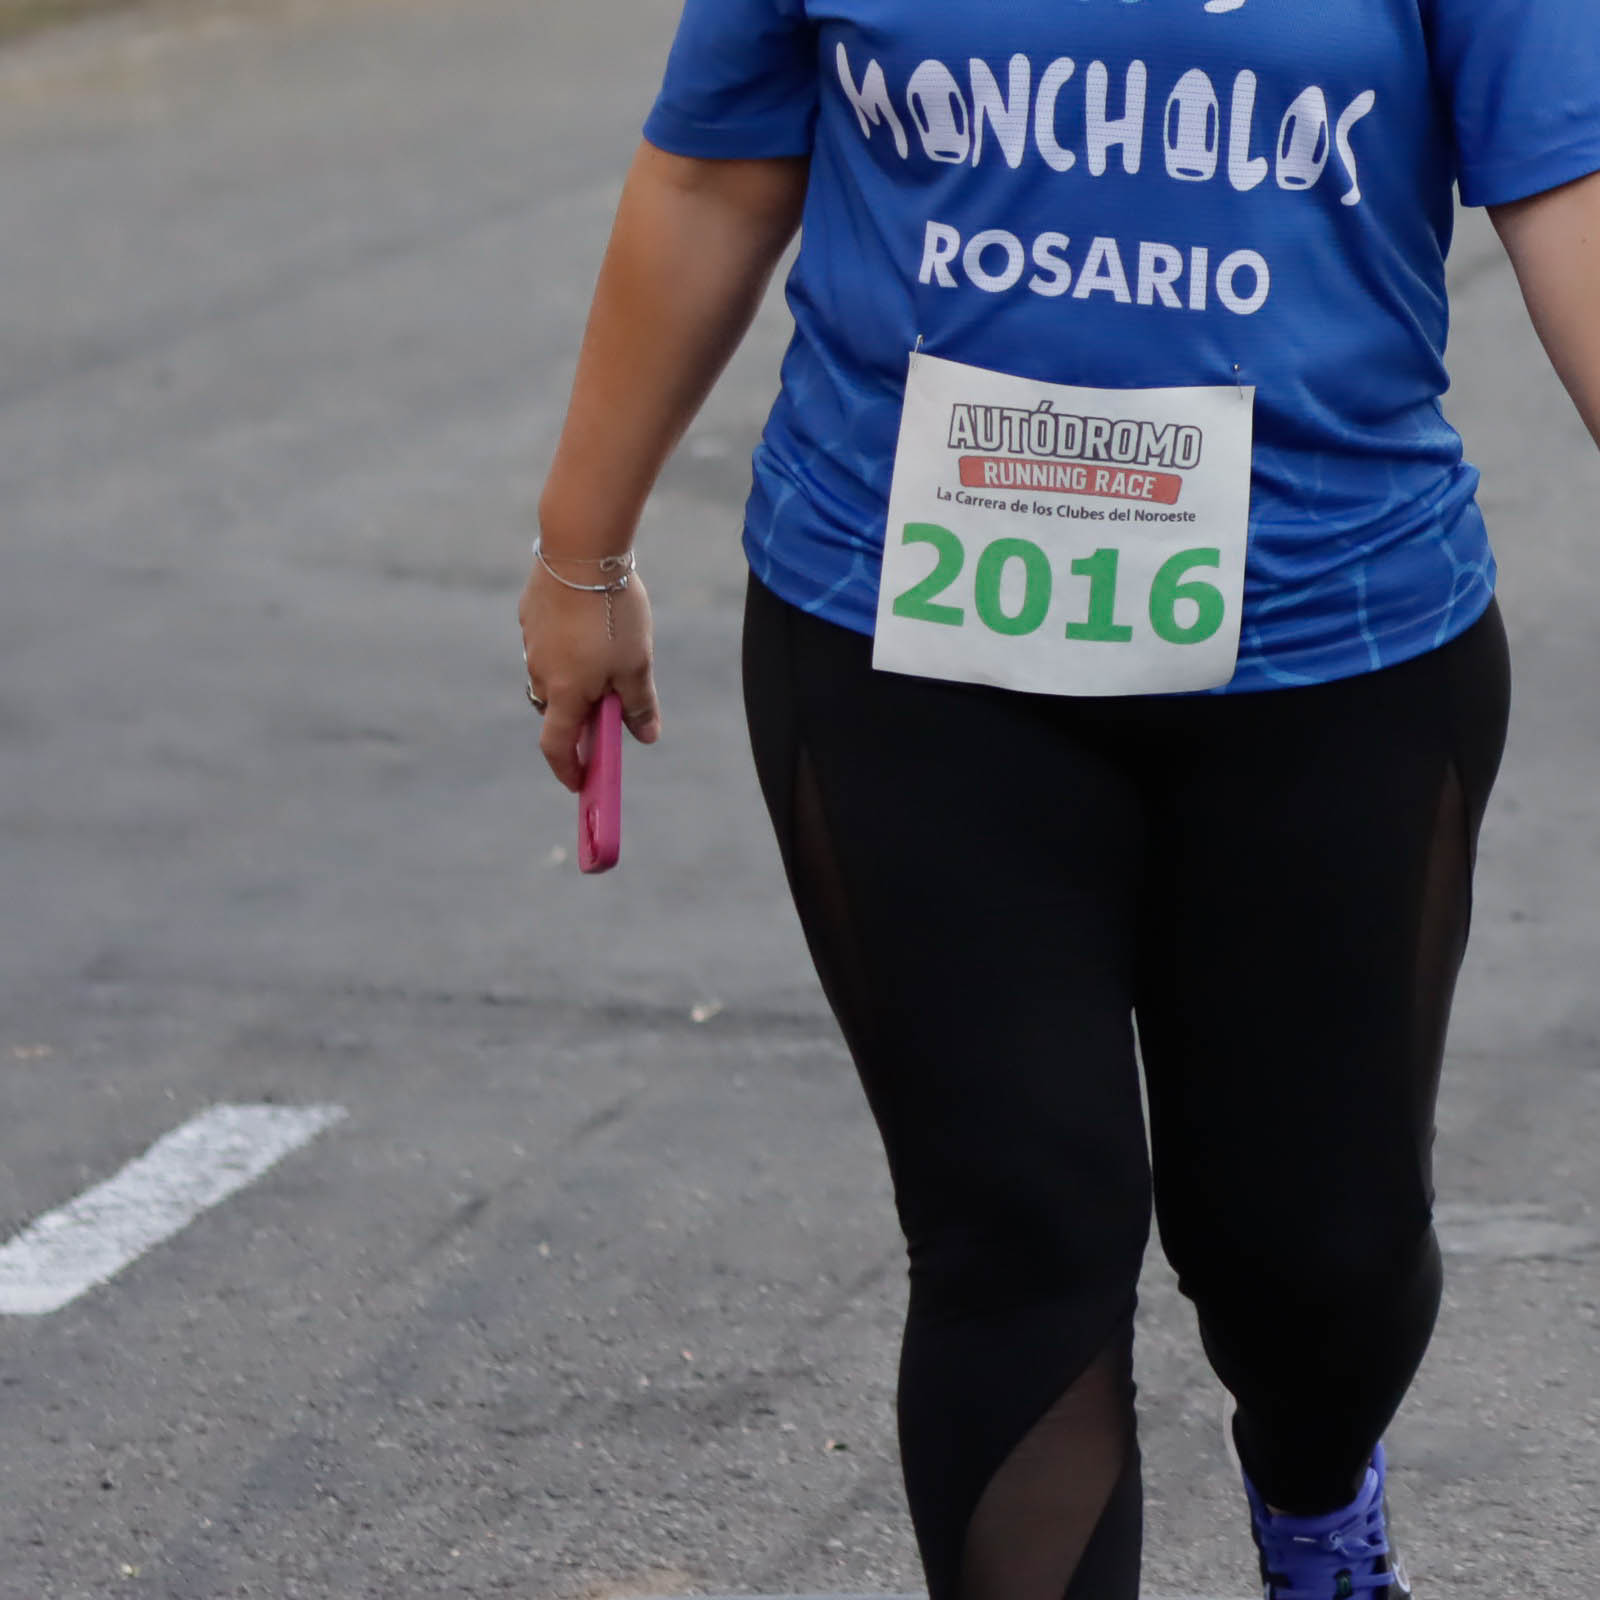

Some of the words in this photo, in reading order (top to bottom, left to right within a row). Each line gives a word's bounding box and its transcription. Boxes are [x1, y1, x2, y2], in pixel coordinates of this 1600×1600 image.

[836, 42, 1375, 205] MONCHOLOS
[918, 220, 1269, 315] ROSARIO
[948, 400, 1202, 469] AUTÓDROMO
[936, 487, 952, 502] La
[956, 492, 1007, 510] Carrera
[1011, 499, 1028, 514] de
[1033, 502, 1052, 517] los
[1057, 505, 1105, 521] Clubes
[1109, 508, 1131, 522] del
[1134, 509, 1196, 522] Noroeste
[984, 462, 1087, 491] RUNNING
[1095, 470, 1156, 499] RACE
[892, 522, 1225, 645] 2016
